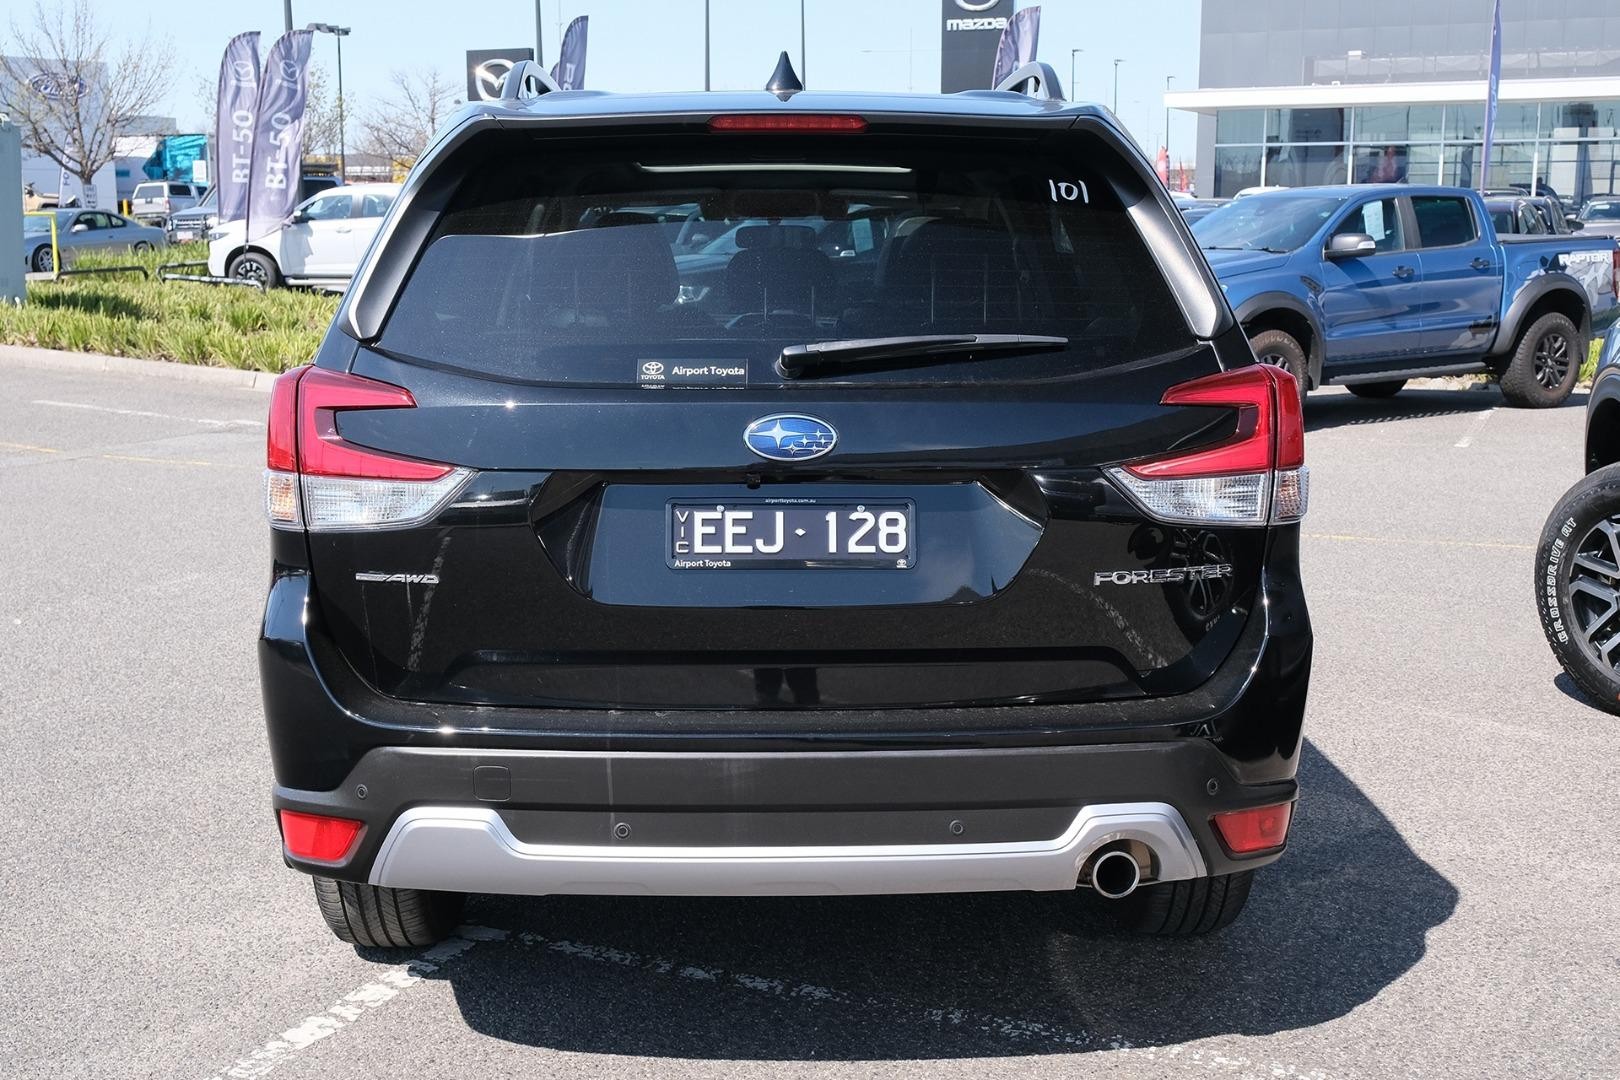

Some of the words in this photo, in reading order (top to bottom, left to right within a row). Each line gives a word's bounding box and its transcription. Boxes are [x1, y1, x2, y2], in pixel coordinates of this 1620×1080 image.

[946, 17, 1008, 31] mazda
[232, 109, 254, 184] BT-50
[265, 112, 292, 190] BT-50
[1049, 179, 1089, 203] 101
[1558, 252, 1611, 266] RAPTOR
[672, 366, 708, 376] Airport
[710, 366, 745, 376] Toyota
[676, 511, 689, 553] VIC
[694, 511, 784, 553] EEJ
[825, 511, 907, 553] 128
[1561, 517, 1577, 537] AT
[674, 560, 703, 568] Airport
[705, 560, 731, 568] Toyota
[1094, 563, 1233, 586] FORESTER
